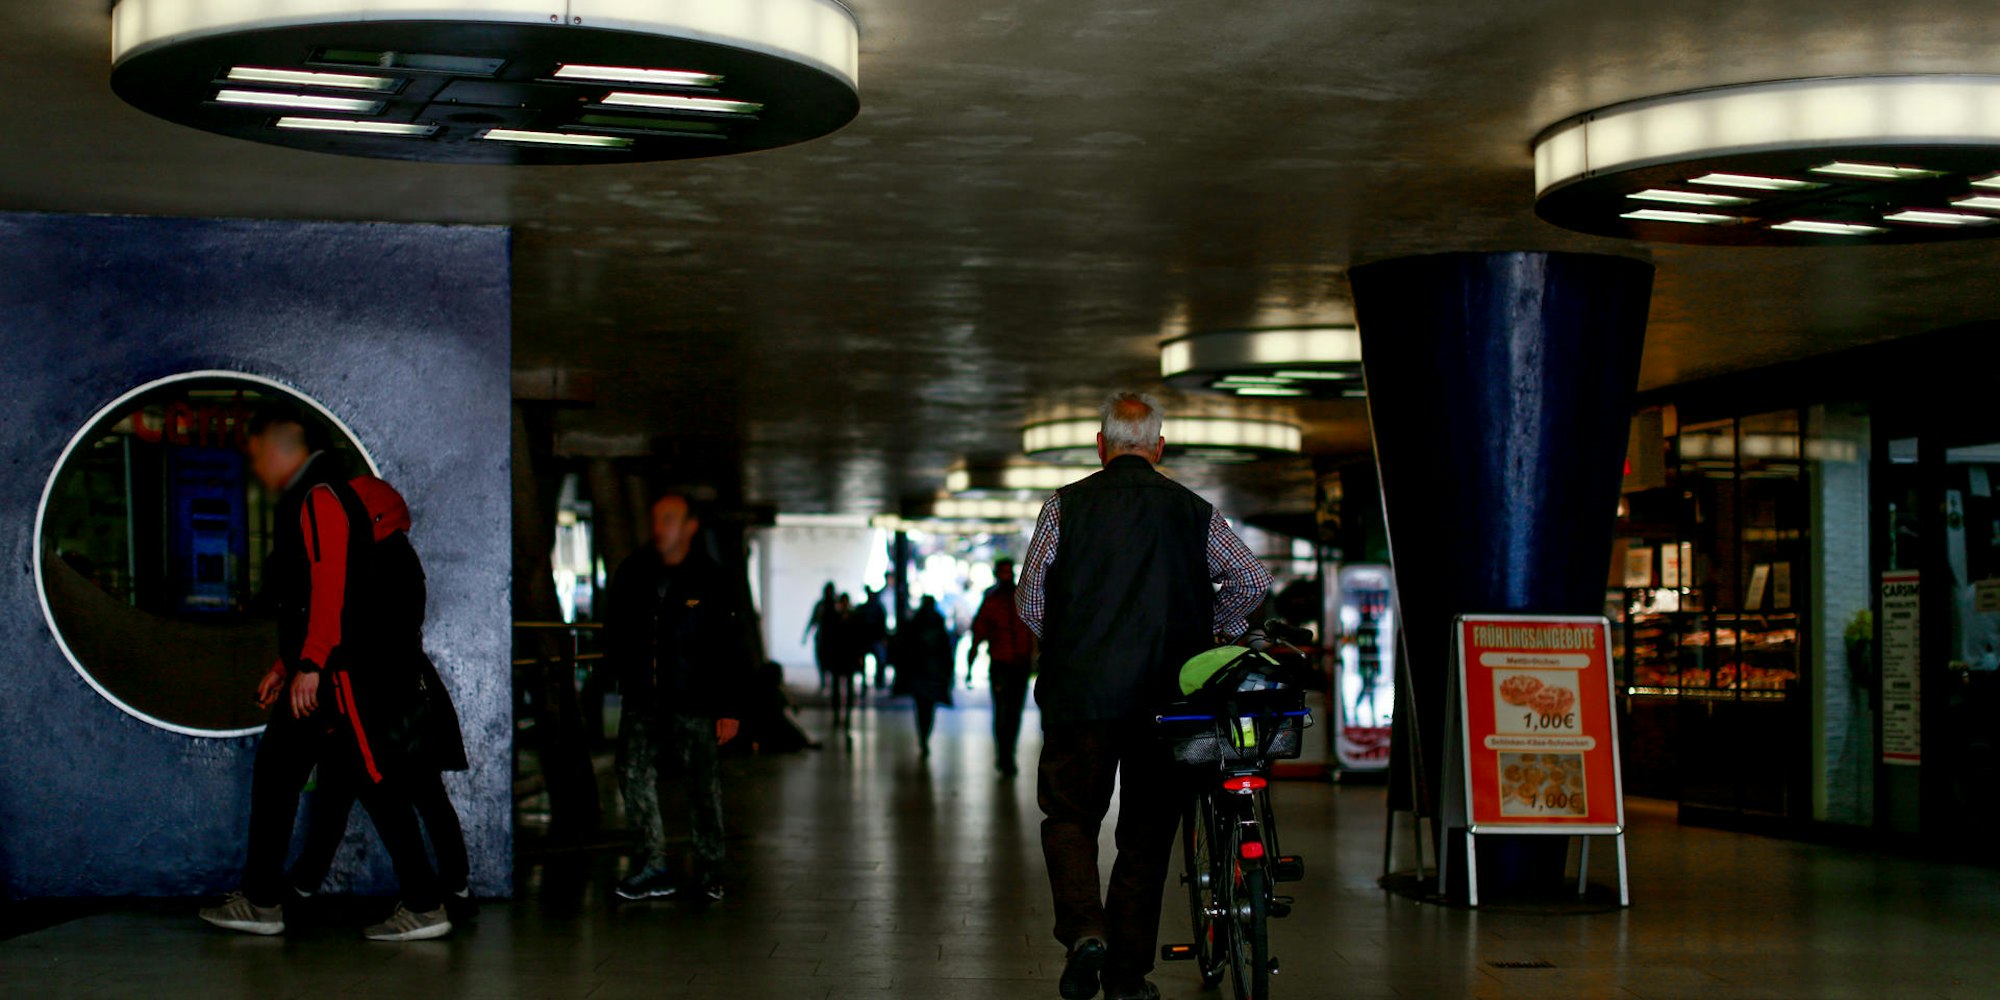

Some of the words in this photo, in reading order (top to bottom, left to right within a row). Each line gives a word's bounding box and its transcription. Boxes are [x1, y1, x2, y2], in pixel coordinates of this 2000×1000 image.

[1472, 624, 1596, 649] FRÜHLINGSANGEBOTE
[1524, 712, 1575, 731] 1,00€
[1530, 793, 1581, 812] 1,00€
